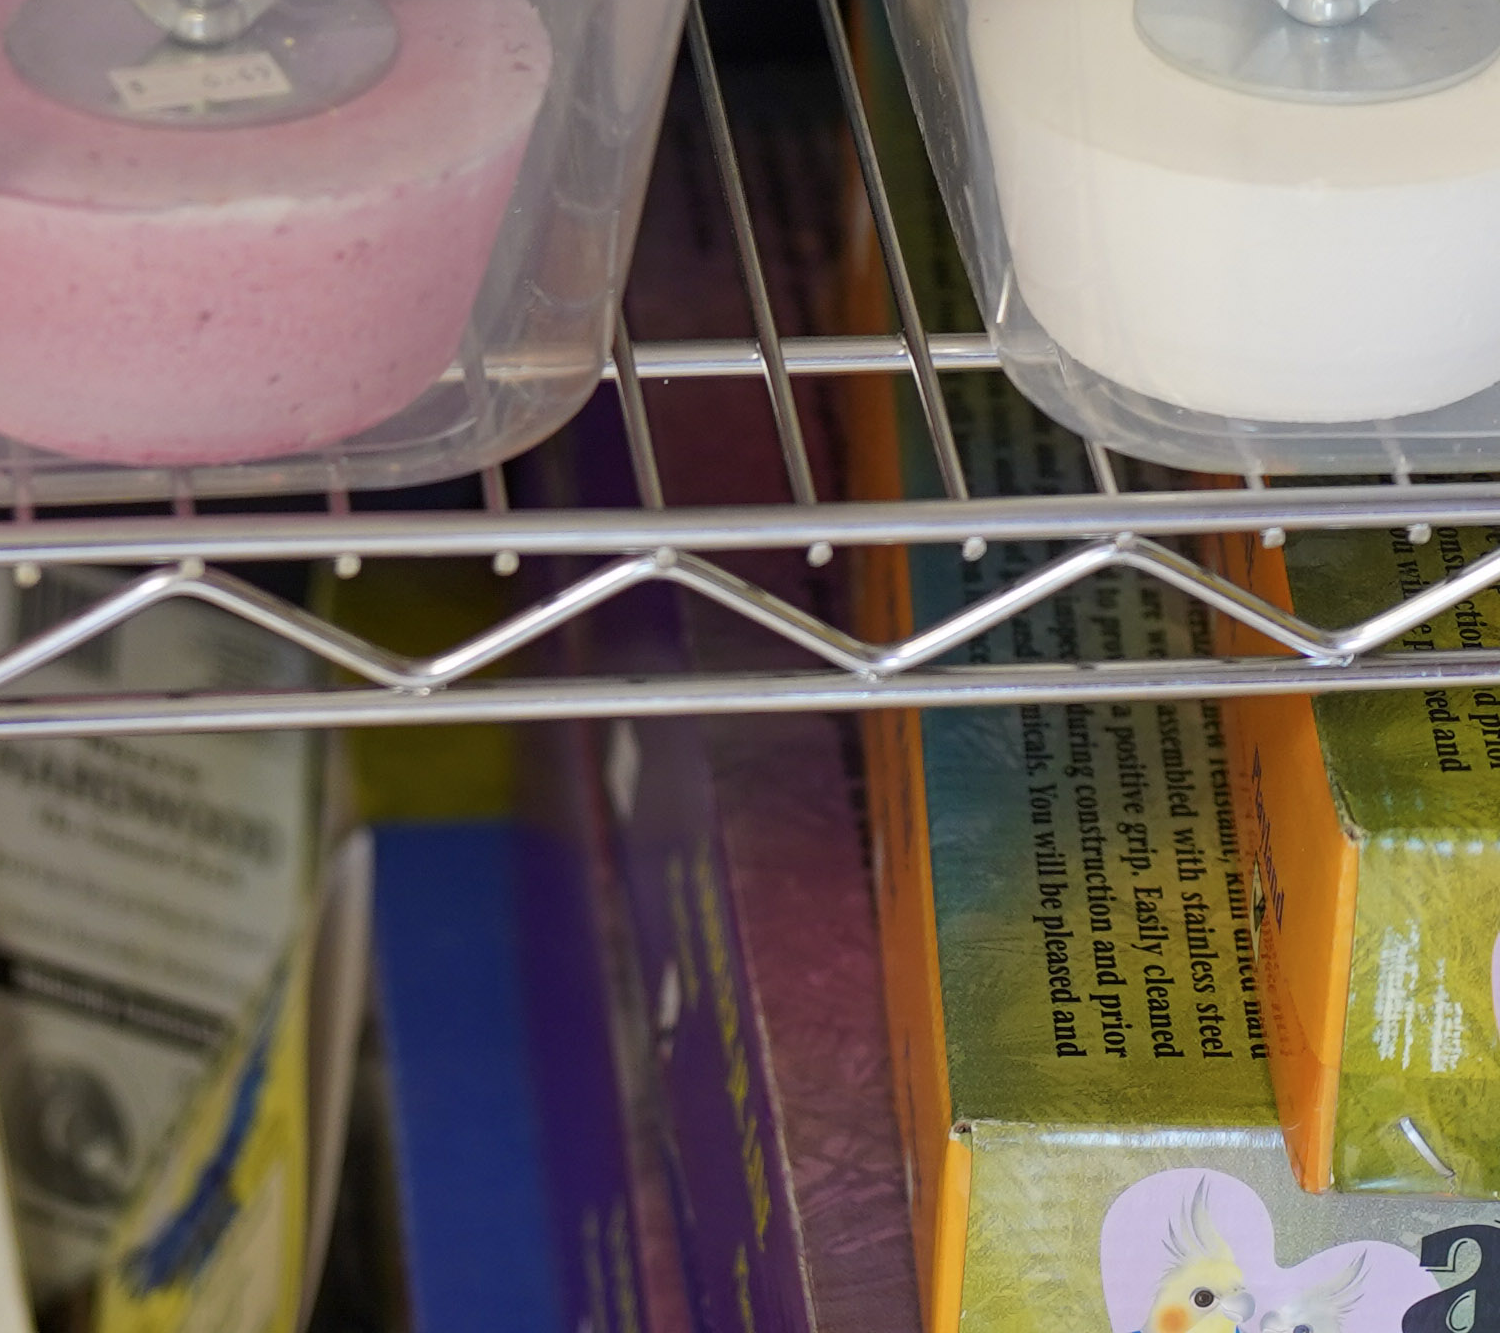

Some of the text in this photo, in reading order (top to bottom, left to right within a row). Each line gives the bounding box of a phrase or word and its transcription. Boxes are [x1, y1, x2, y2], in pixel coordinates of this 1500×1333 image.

[1065, 704, 1101, 778] during
[1106, 726, 1151, 814] positive
[1157, 706, 1200, 818] assembled
[1432, 728, 1471, 773] and
[1027, 783, 1061, 825] You
[1033, 831, 1071, 879] will
[1075, 786, 1116, 932] construction
[1117, 822, 1157, 877] grip.
[1174, 828, 1207, 883] with
[1038, 883, 1074, 911] be
[1132, 886, 1169, 955] Easily
[1030, 915, 1082, 1004] pleased
[1093, 940, 1127, 986] and
[1182, 892, 1221, 994] stainless
[1053, 1009, 1088, 1058] and
[1088, 992, 1134, 1059] prior
[1143, 965, 1185, 1059] cleaned
[1197, 1003, 1232, 1059] steel
